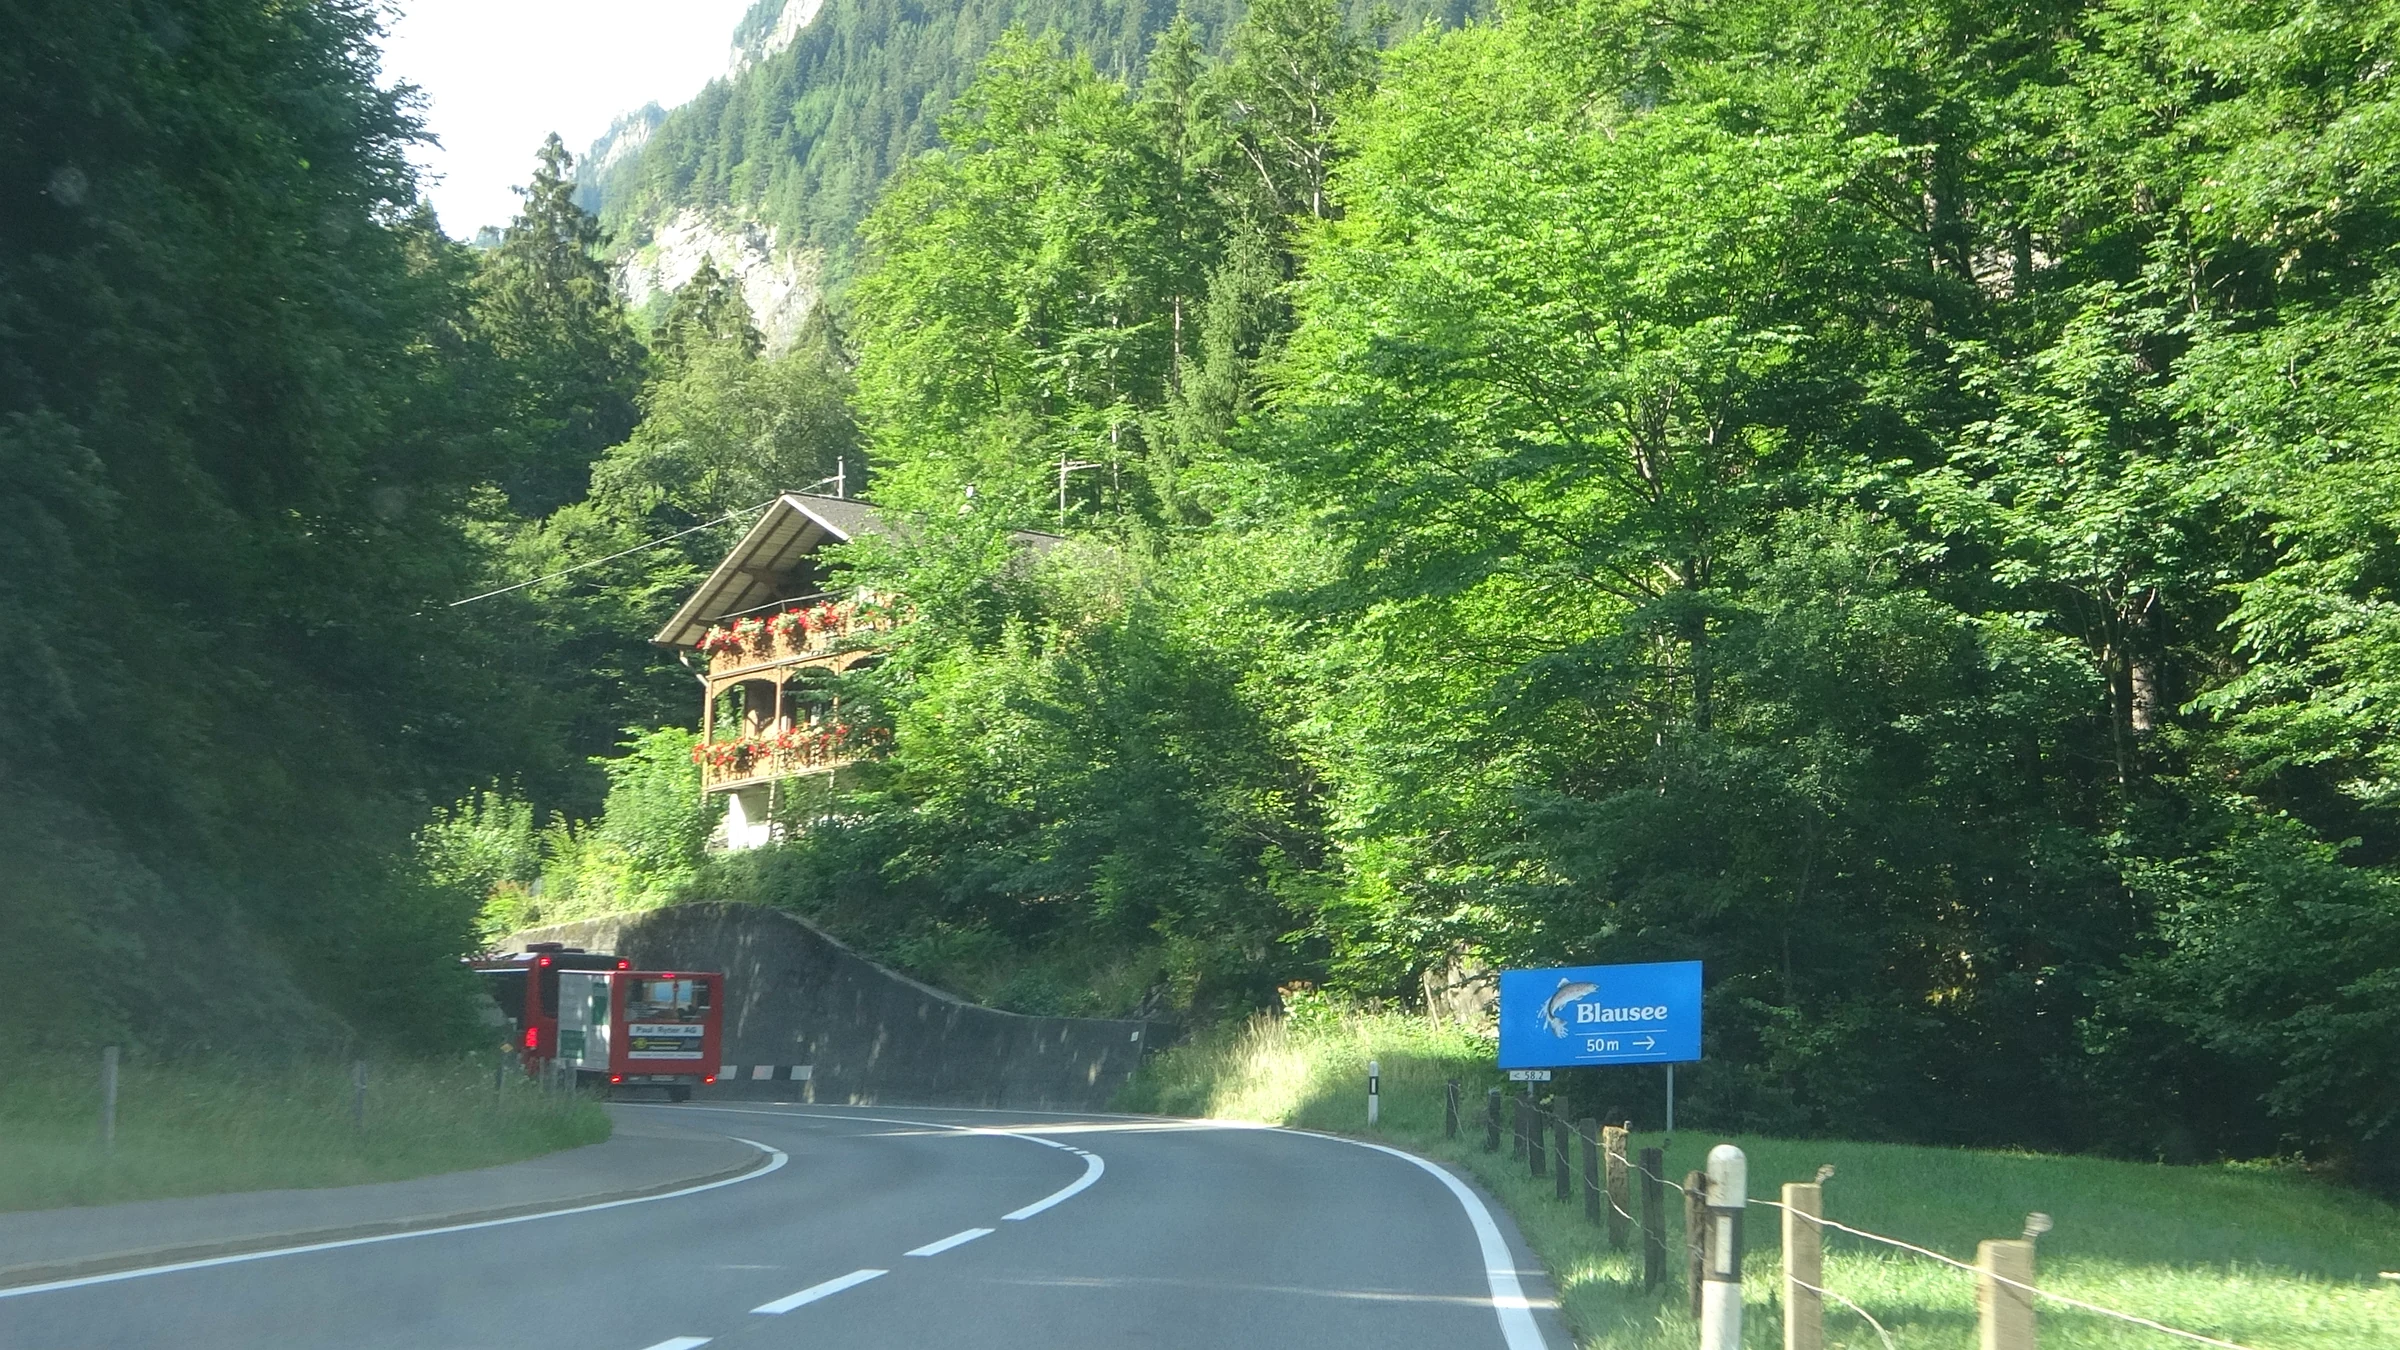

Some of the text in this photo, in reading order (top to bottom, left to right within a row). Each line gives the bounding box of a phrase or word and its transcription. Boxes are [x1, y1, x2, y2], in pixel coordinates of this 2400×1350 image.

[1577, 1003, 1668, 1023] Blausee
[1586, 1038, 1619, 1052] 50 m
[1525, 1071, 1544, 1080] 58.2
